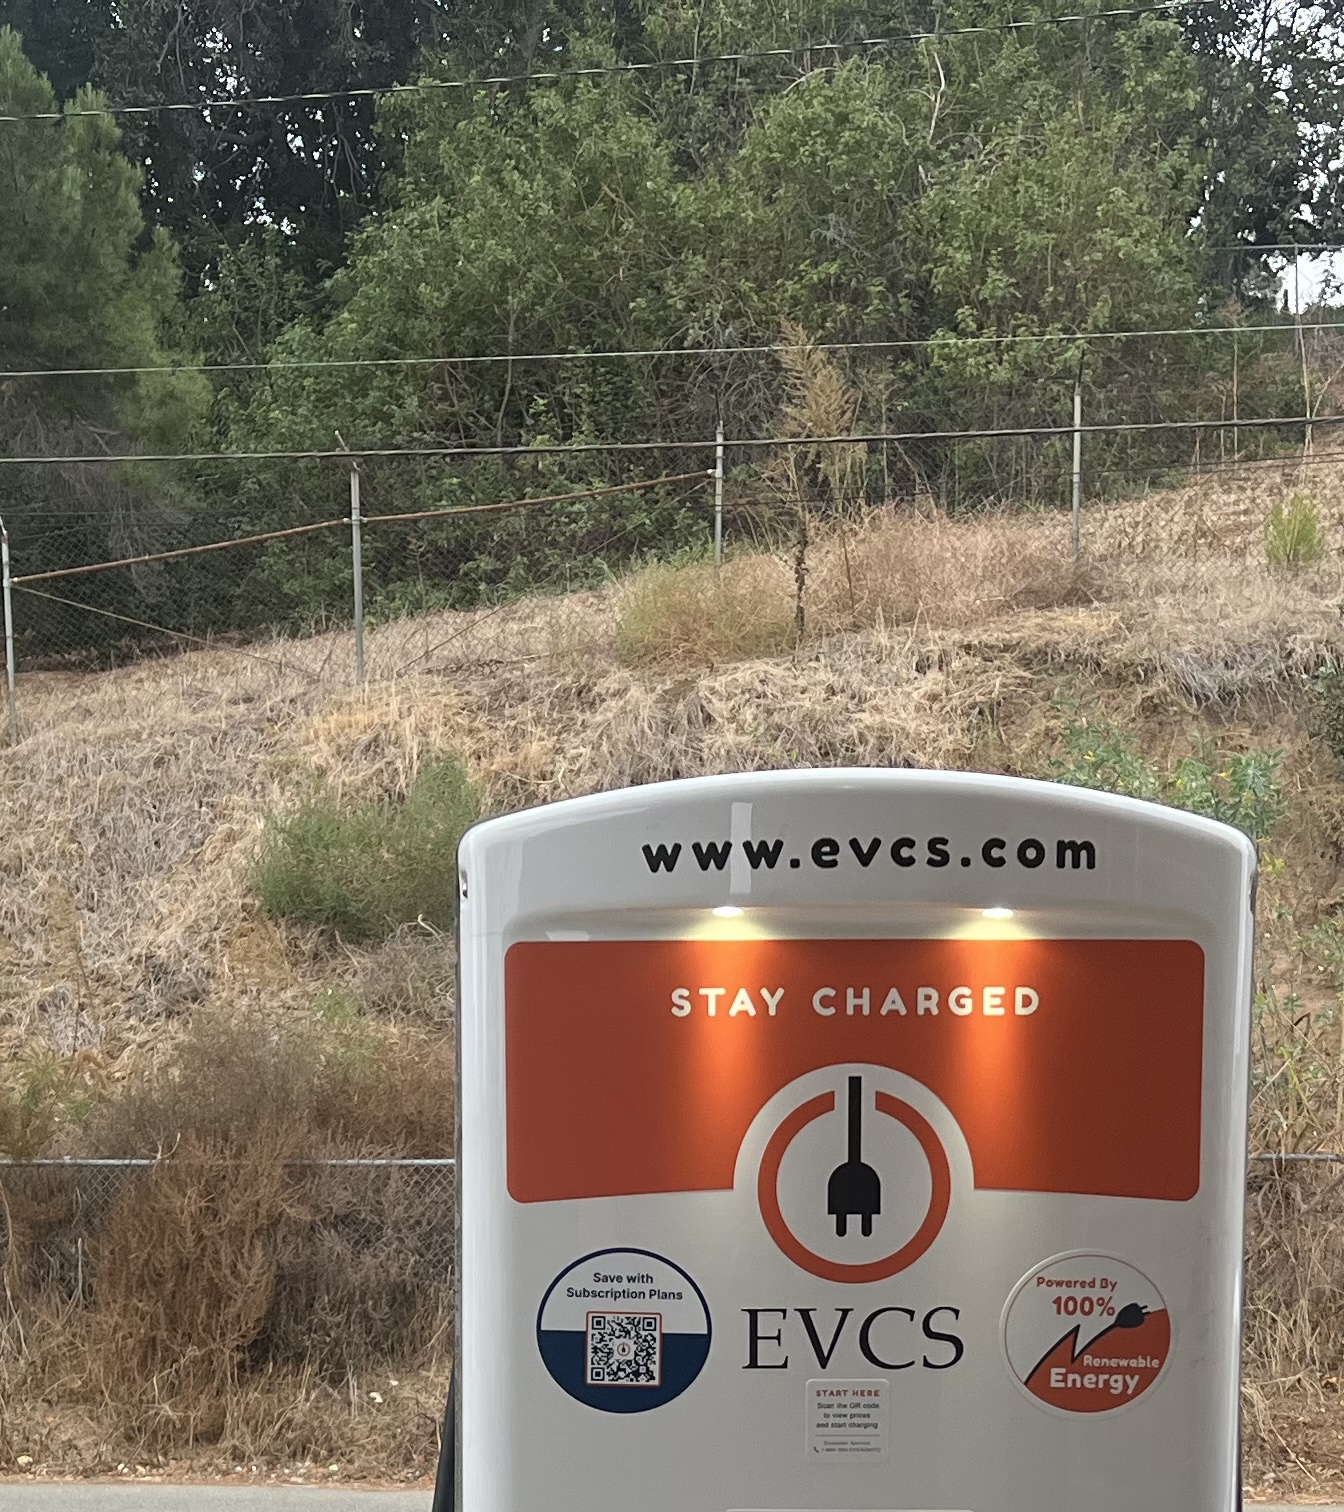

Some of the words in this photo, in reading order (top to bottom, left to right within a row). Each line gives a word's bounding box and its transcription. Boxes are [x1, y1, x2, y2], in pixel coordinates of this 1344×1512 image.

[642, 835, 1097, 873] www.evcs.com
[670, 986, 785, 1018] STAY
[812, 985, 1040, 1017] CHARGED
[593, 1272, 623, 1284] Save
[626, 1273, 653, 1284] with
[1036, 1276, 1096, 1289] Powered
[1100, 1278, 1117, 1292] By
[566, 1287, 646, 1301] Subscription
[649, 1289, 683, 1300] Plans
[1052, 1295, 1116, 1317] 100%
[741, 1307, 964, 1369] EVCS
[1083, 1355, 1160, 1368] Renewable
[1050, 1368, 1140, 1395] Energy
[815, 1389, 848, 1397] START
[852, 1389, 880, 1397] HERE
[848, 1422, 878, 1430] charging
